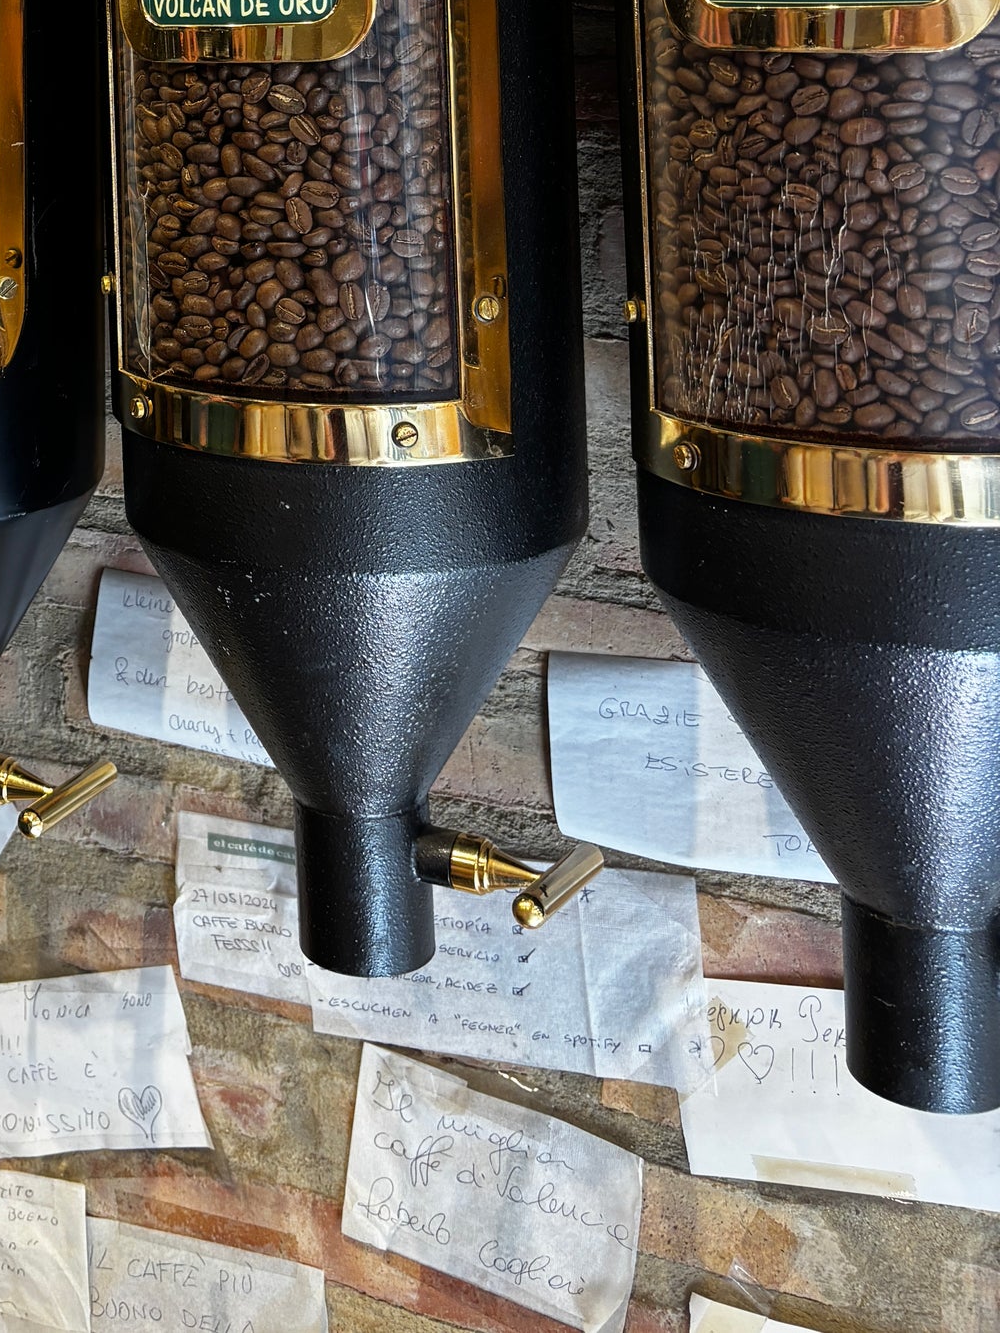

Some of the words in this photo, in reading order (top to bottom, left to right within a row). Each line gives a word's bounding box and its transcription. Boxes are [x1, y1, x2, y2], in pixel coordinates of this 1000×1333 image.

[599, 697, 703, 727] GRAZIE
[169, 713, 221, 743] Charly
[213, 839, 225, 848] el
[228, 842, 257, 853] café
[259, 846, 275, 857] de
[244, 919, 292, 937] BUONO
[328, 995, 412, 1018] ESCUCHEN
[428, 1013, 438, 1024] A
[532, 1031, 550, 1041] EN
[8, 1207, 59, 1226] BUENO
[90, 1285, 162, 1321] BUONO
